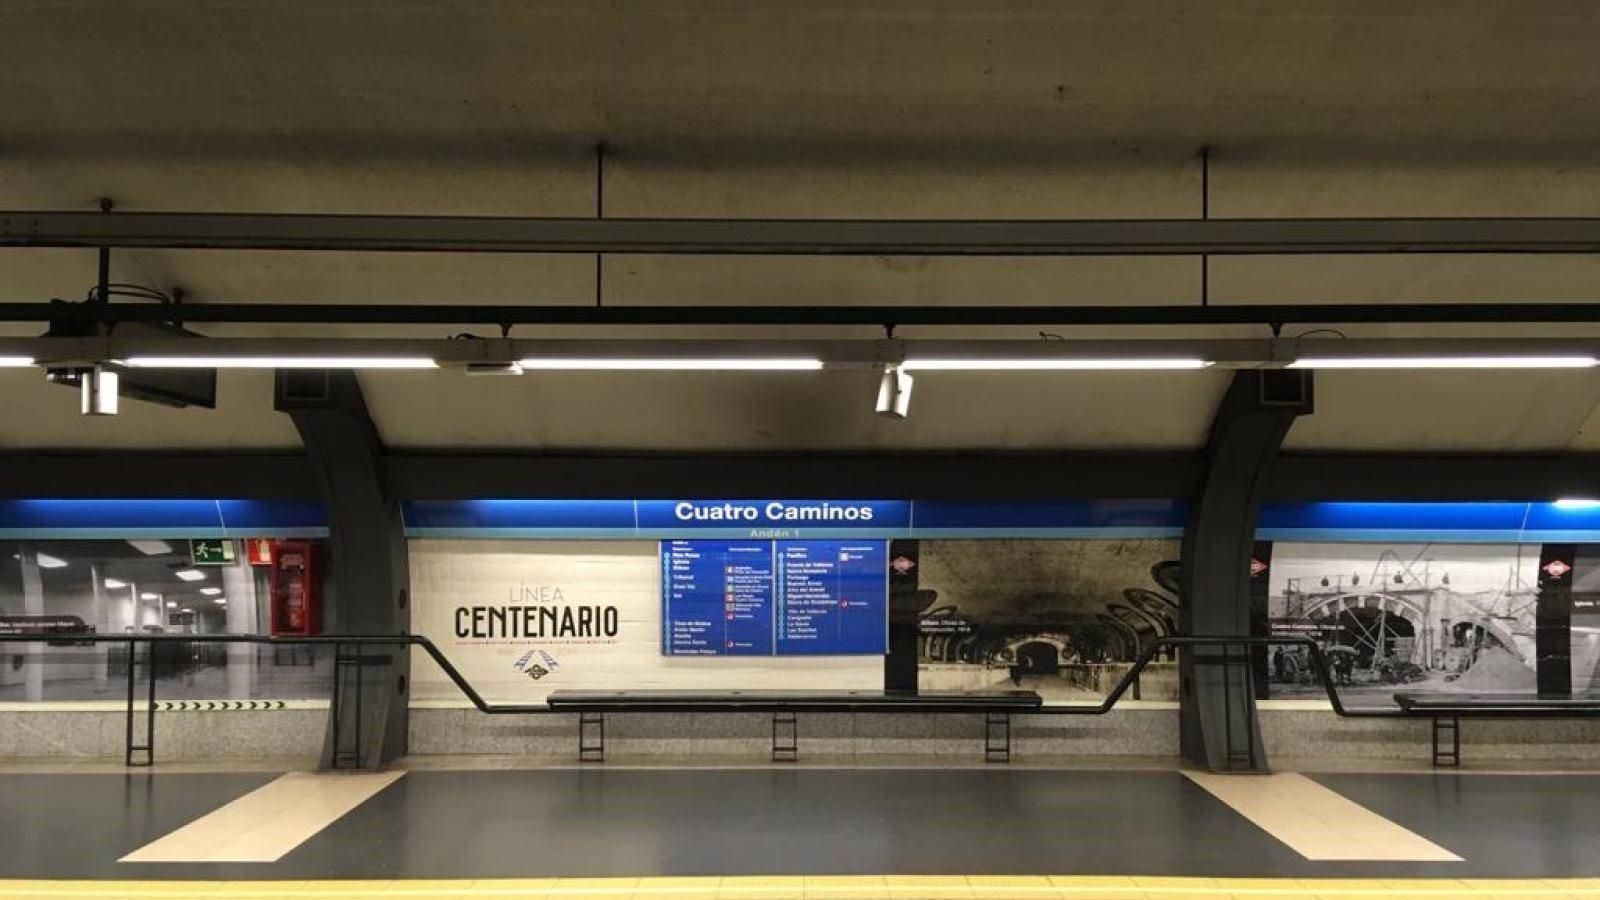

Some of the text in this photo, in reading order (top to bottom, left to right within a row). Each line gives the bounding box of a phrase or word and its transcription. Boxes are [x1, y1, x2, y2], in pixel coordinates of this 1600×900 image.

[675, 502, 873, 520] Cuatro Caminos
[750, 528, 789, 538] Andén
[510, 581, 564, 601] LÍNEA
[455, 606, 618, 638] CENTENARIO
